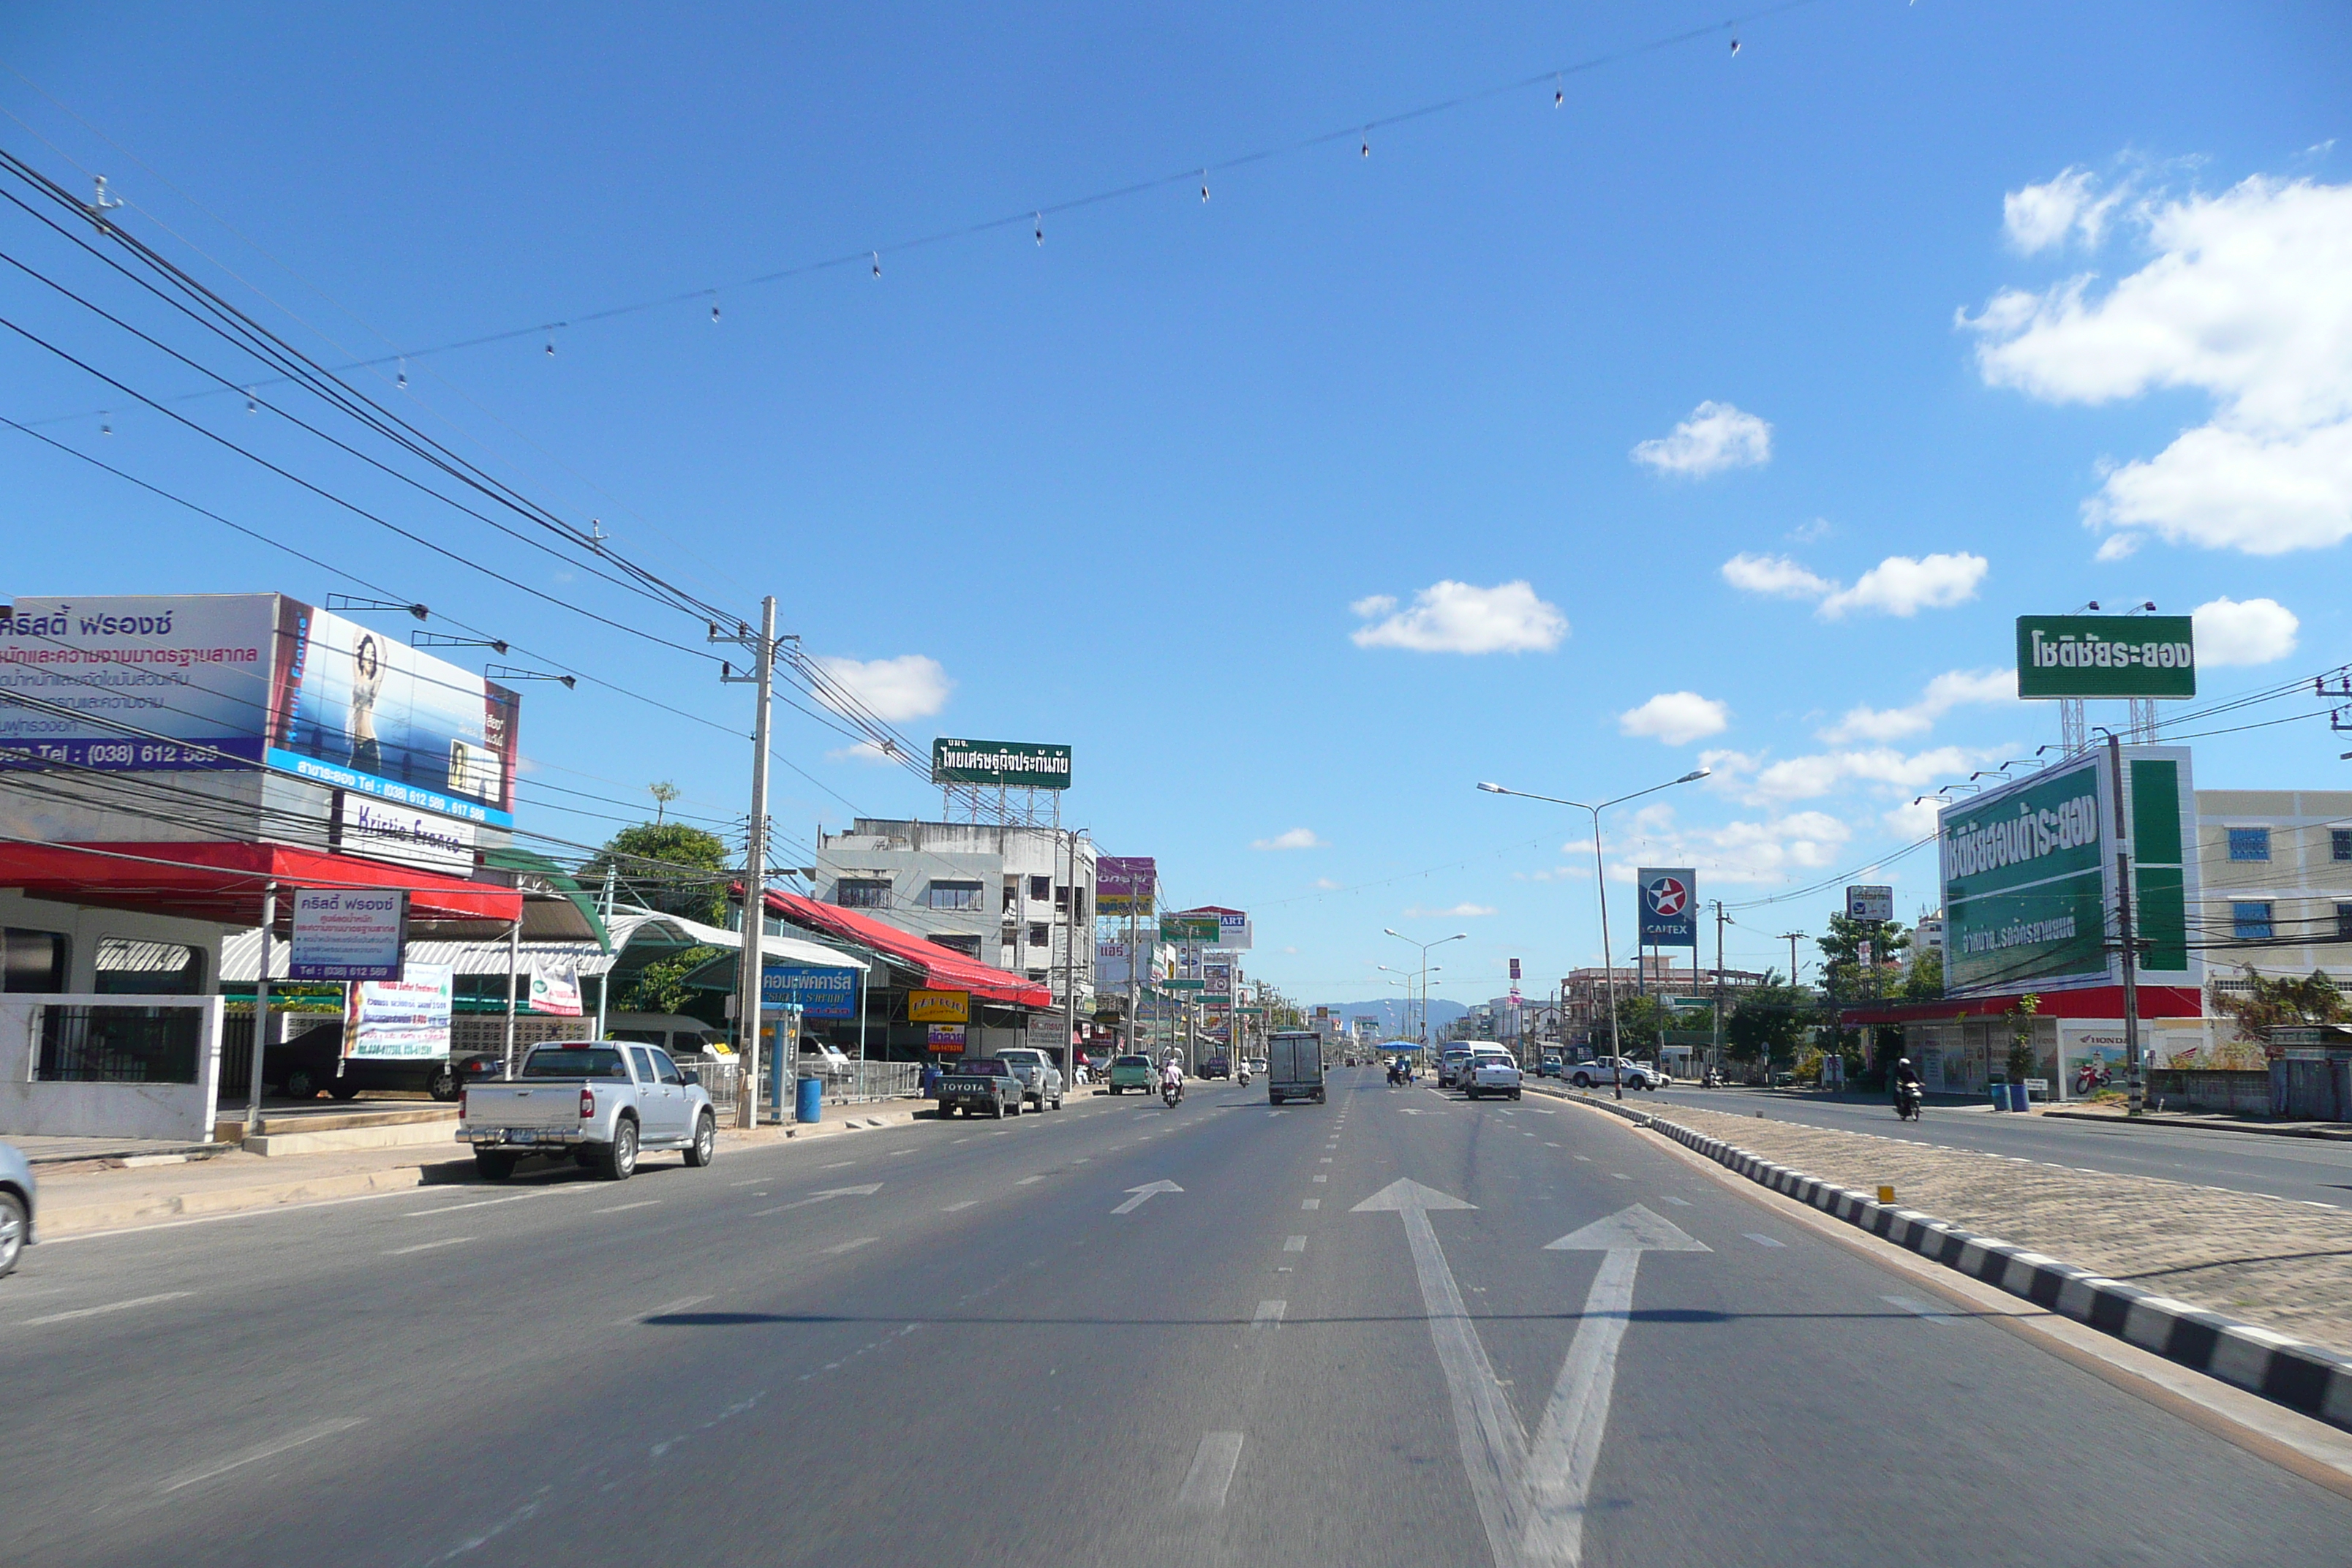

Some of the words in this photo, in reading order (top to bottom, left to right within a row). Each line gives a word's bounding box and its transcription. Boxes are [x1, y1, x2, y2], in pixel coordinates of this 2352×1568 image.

[2031, 630, 2191, 668] โชติชัยระยอง
[38, 745, 68, 762] Tel
[88, 745, 134, 766] (038)
[141, 745, 177, 762] 612
[941, 746, 1068, 775] ไทยเศรษฐกิจประกันภัย
[358, 775, 374, 792] Tel
[383, 783, 407, 802] (038)
[409, 792, 426, 804] 612
[452, 802, 467, 816] 617
[1647, 924, 1688, 935] CALTEX
[299, 966, 315, 975] Tel
[943, 1083, 984, 1091] TOYOTA
